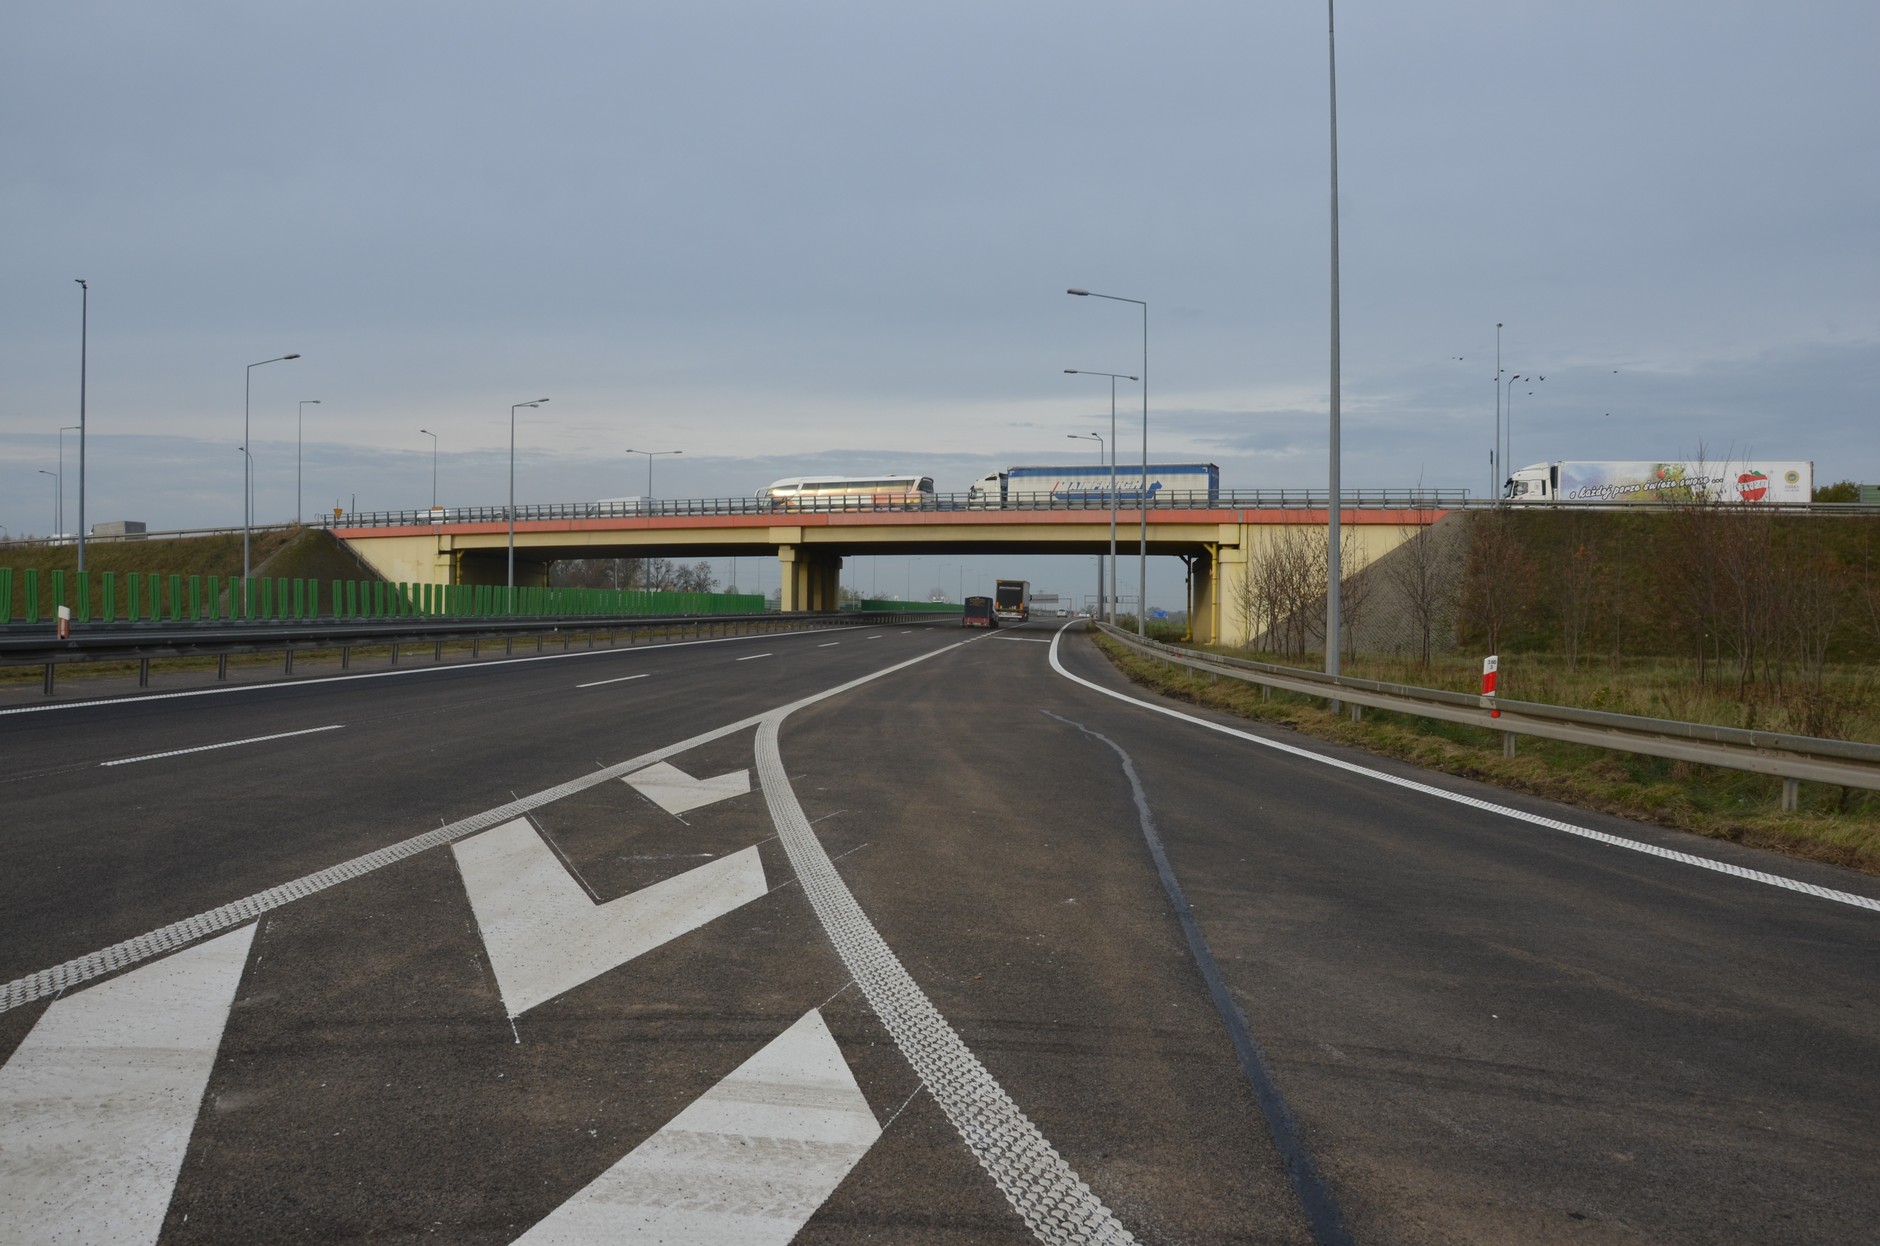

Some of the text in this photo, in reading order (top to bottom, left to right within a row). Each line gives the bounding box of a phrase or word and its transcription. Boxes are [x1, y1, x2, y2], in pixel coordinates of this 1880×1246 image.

[1578, 484, 1612, 500] każdej
[1612, 486, 1640, 499] porze
[1644, 479, 1676, 491] świeże
